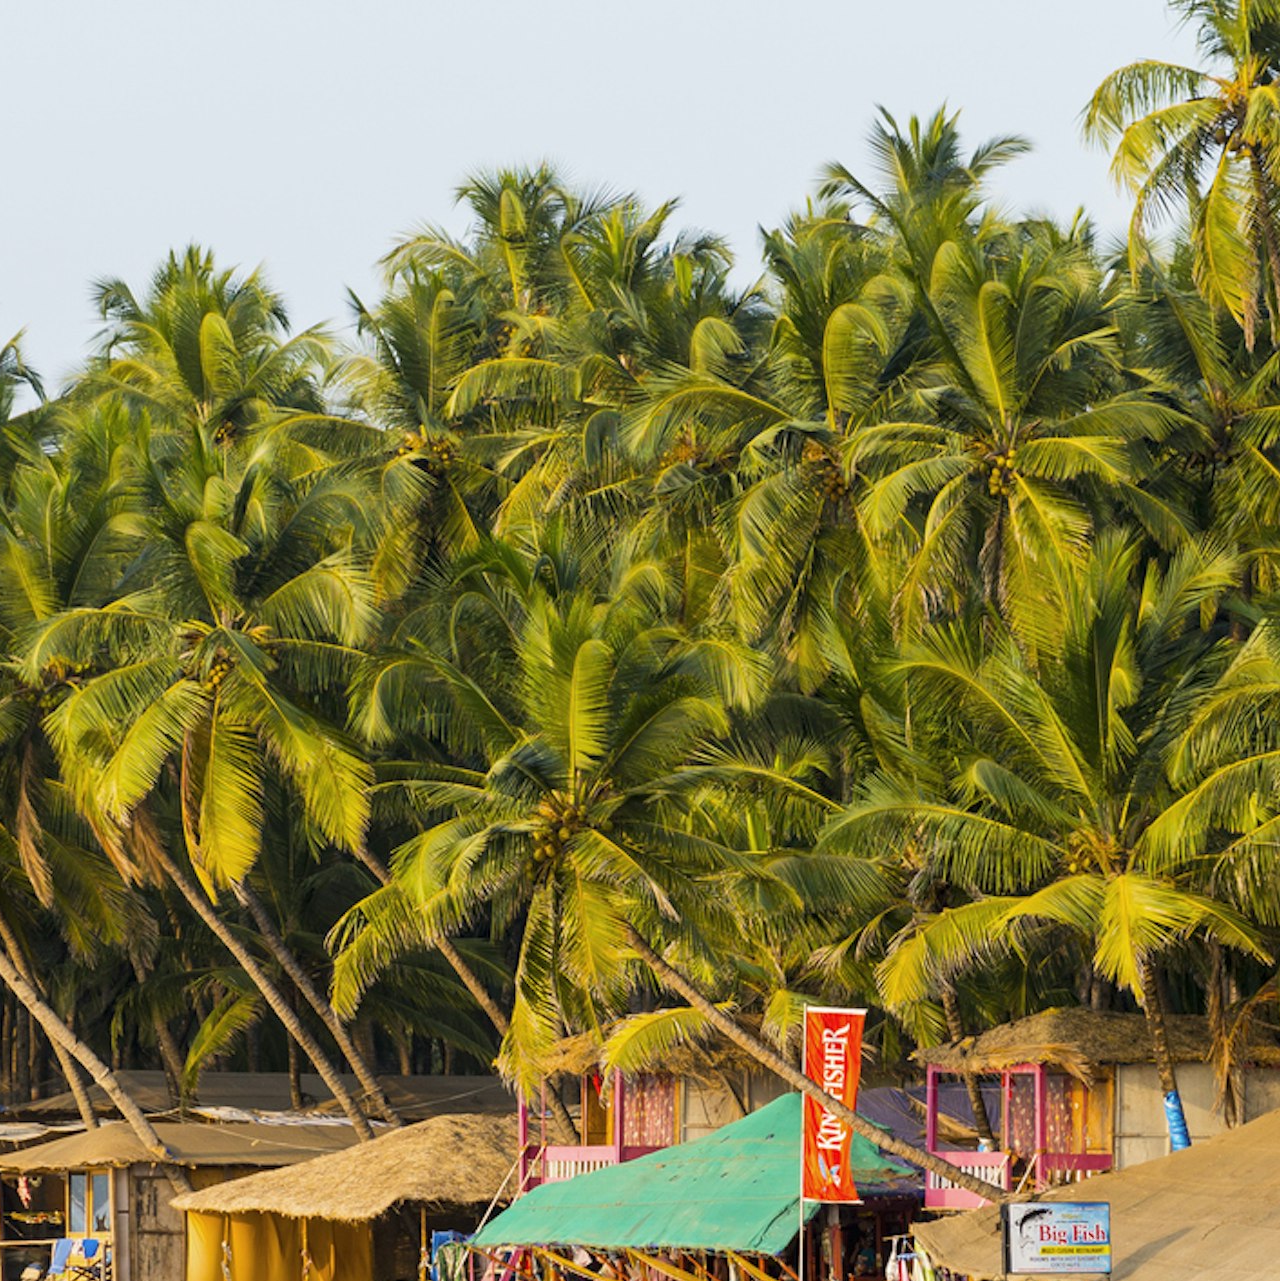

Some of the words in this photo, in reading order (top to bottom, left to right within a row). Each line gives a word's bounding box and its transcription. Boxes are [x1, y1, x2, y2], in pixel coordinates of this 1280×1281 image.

[817, 1023, 851, 1151] KINFISHER
[1039, 1225, 1067, 1245] Big
[1072, 1223, 1106, 1241] Fish
